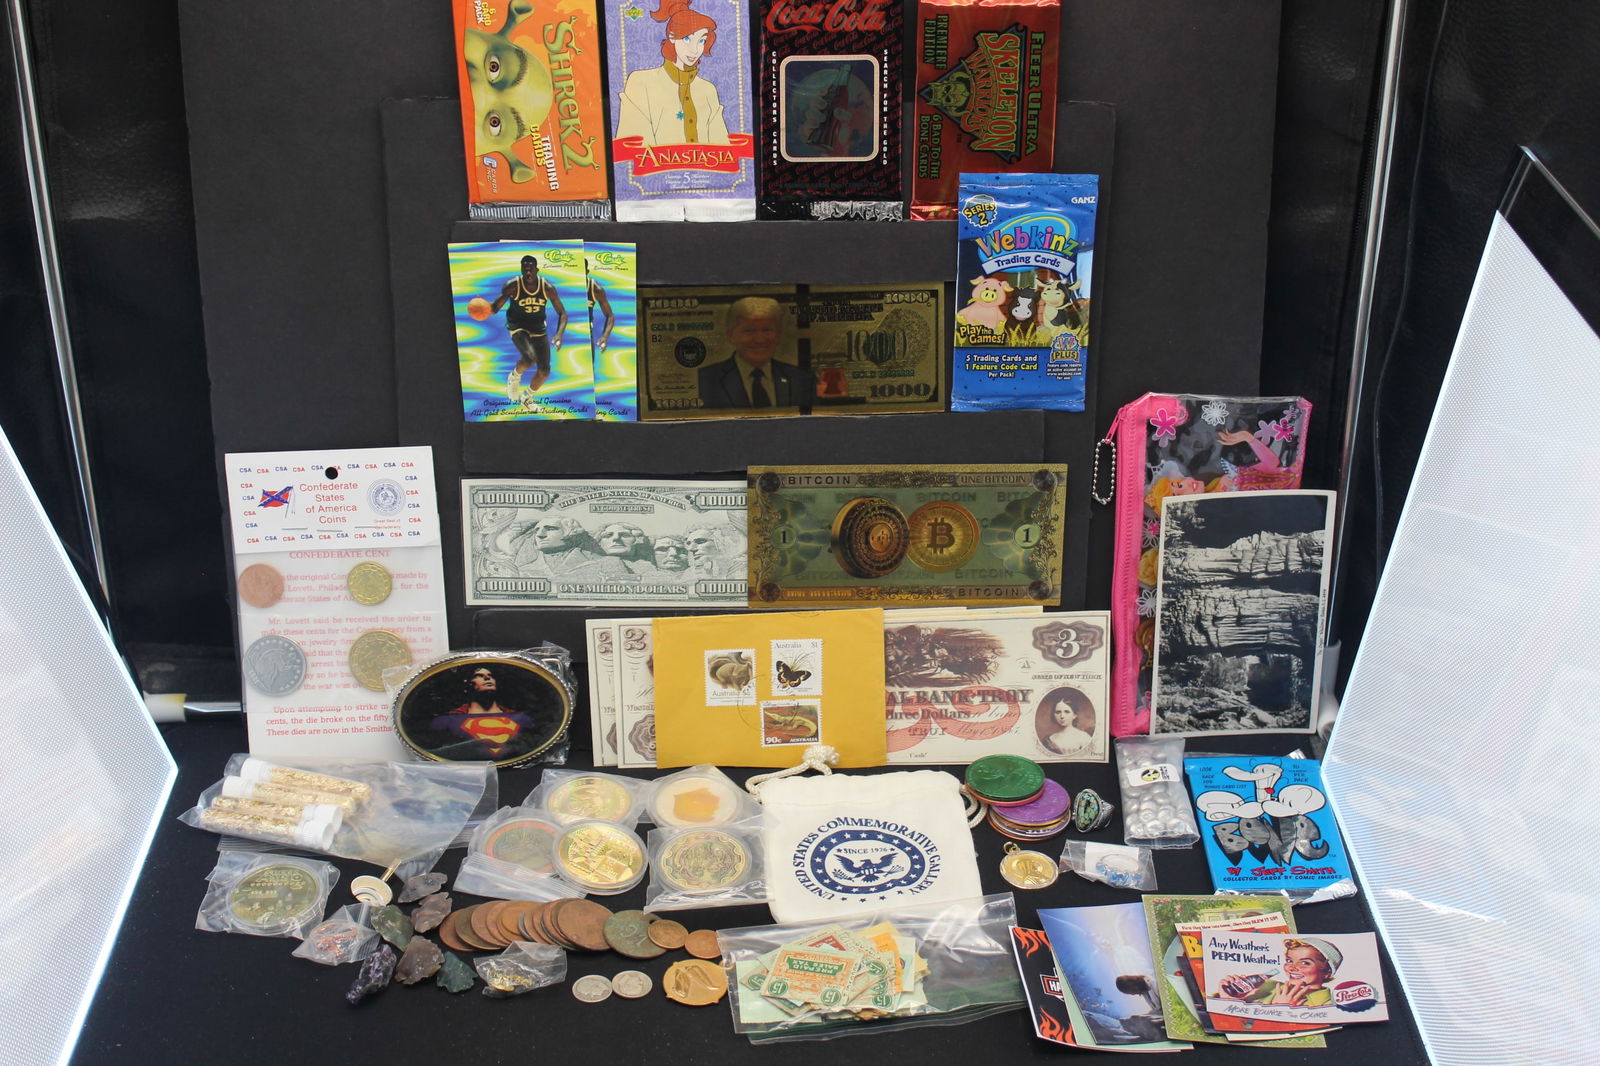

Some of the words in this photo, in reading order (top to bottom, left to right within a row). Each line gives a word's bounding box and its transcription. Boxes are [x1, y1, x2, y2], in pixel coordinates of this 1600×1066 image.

[473, 0, 484, 24] PACK
[481, 1, 491, 26] CARD
[924, 19, 936, 64] EDITION
[936, 14, 948, 70] PREMIERE
[1029, 32, 1045, 92] FLEER
[974, 33, 1020, 152] SKELETON
[920, 115, 931, 143] BONE
[1025, 92, 1042, 155] ULTRA
[932, 124, 942, 144] BAD
[530, 125, 545, 167] CARDS
[562, 137, 600, 170] 2
[635, 145, 736, 168] ANASTASIA
[541, 136, 559, 190] TRADING
[919, 144, 930, 178] CARDS
[930, 160, 941, 179] THE
[683, 172, 691, 184] 5
[1071, 196, 1096, 204] GANZ
[963, 202, 996, 219] SERIES
[978, 212, 988, 225] 2
[975, 226, 1079, 258] Webkinz
[995, 255, 1031, 268] Trading
[1034, 254, 1061, 268] Cards
[519, 297, 546, 306] COLE
[960, 325, 982, 336] Play
[651, 335, 663, 343] B2
[969, 334, 1005, 344] Games!
[974, 355, 999, 363] Trading
[1054, 351, 1078, 360] PLUS
[871, 384, 931, 397] 1000
[540, 407, 566, 415] Trading
[788, 476, 850, 485] BITCOIN
[984, 476, 1026, 484] BITCOIN
[299, 482, 358, 492] Confederate
[315, 494, 344, 502] States
[479, 493, 543, 505] 1,000,000
[577, 491, 608, 503] UNITED
[651, 495, 687, 511] AMERICA
[305, 505, 315, 513] of
[318, 504, 357, 513] America
[319, 516, 347, 524] Coins
[1022, 528, 1031, 543] 1
[289, 550, 362, 559] CONFEDERATE
[365, 549, 391, 557] CENT
[300, 573, 329, 581] original
[560, 584, 584, 593] ONE
[587, 584, 636, 593] MILLION
[636, 584, 688, 594] DOLLARS
[958, 588, 1019, 597] BITCOIN
[1055, 628, 1080, 659] 3
[915, 690, 973, 704] BANK
[980, 689, 1033, 704] TROY
[273, 706, 295, 714] Upon
[297, 705, 341, 713] attempting
[921, 708, 970, 719] Dollars
[374, 714, 389, 722] fifty
[817, 816, 938, 855] COMMEMORATIVE
[792, 832, 819, 868] STATES
[909, 854, 941, 895] GALLERY
[794, 869, 835, 900] UNITED
[1208, 937, 1228, 950] Any
[1229, 938, 1270, 951] Weather's
[792, 959, 809, 967] TAX
[1211, 951, 1241, 963] PEPSI
[1243, 952, 1280, 966] Weather!
[793, 965, 833, 974] PREPAID
[813, 961, 839, 970] SALES
[772, 983, 782, 993] 15
[825, 992, 836, 1003] 15
[1224, 1004, 1249, 1014] MORE
[1253, 1008, 1283, 1016] BOUNCE
